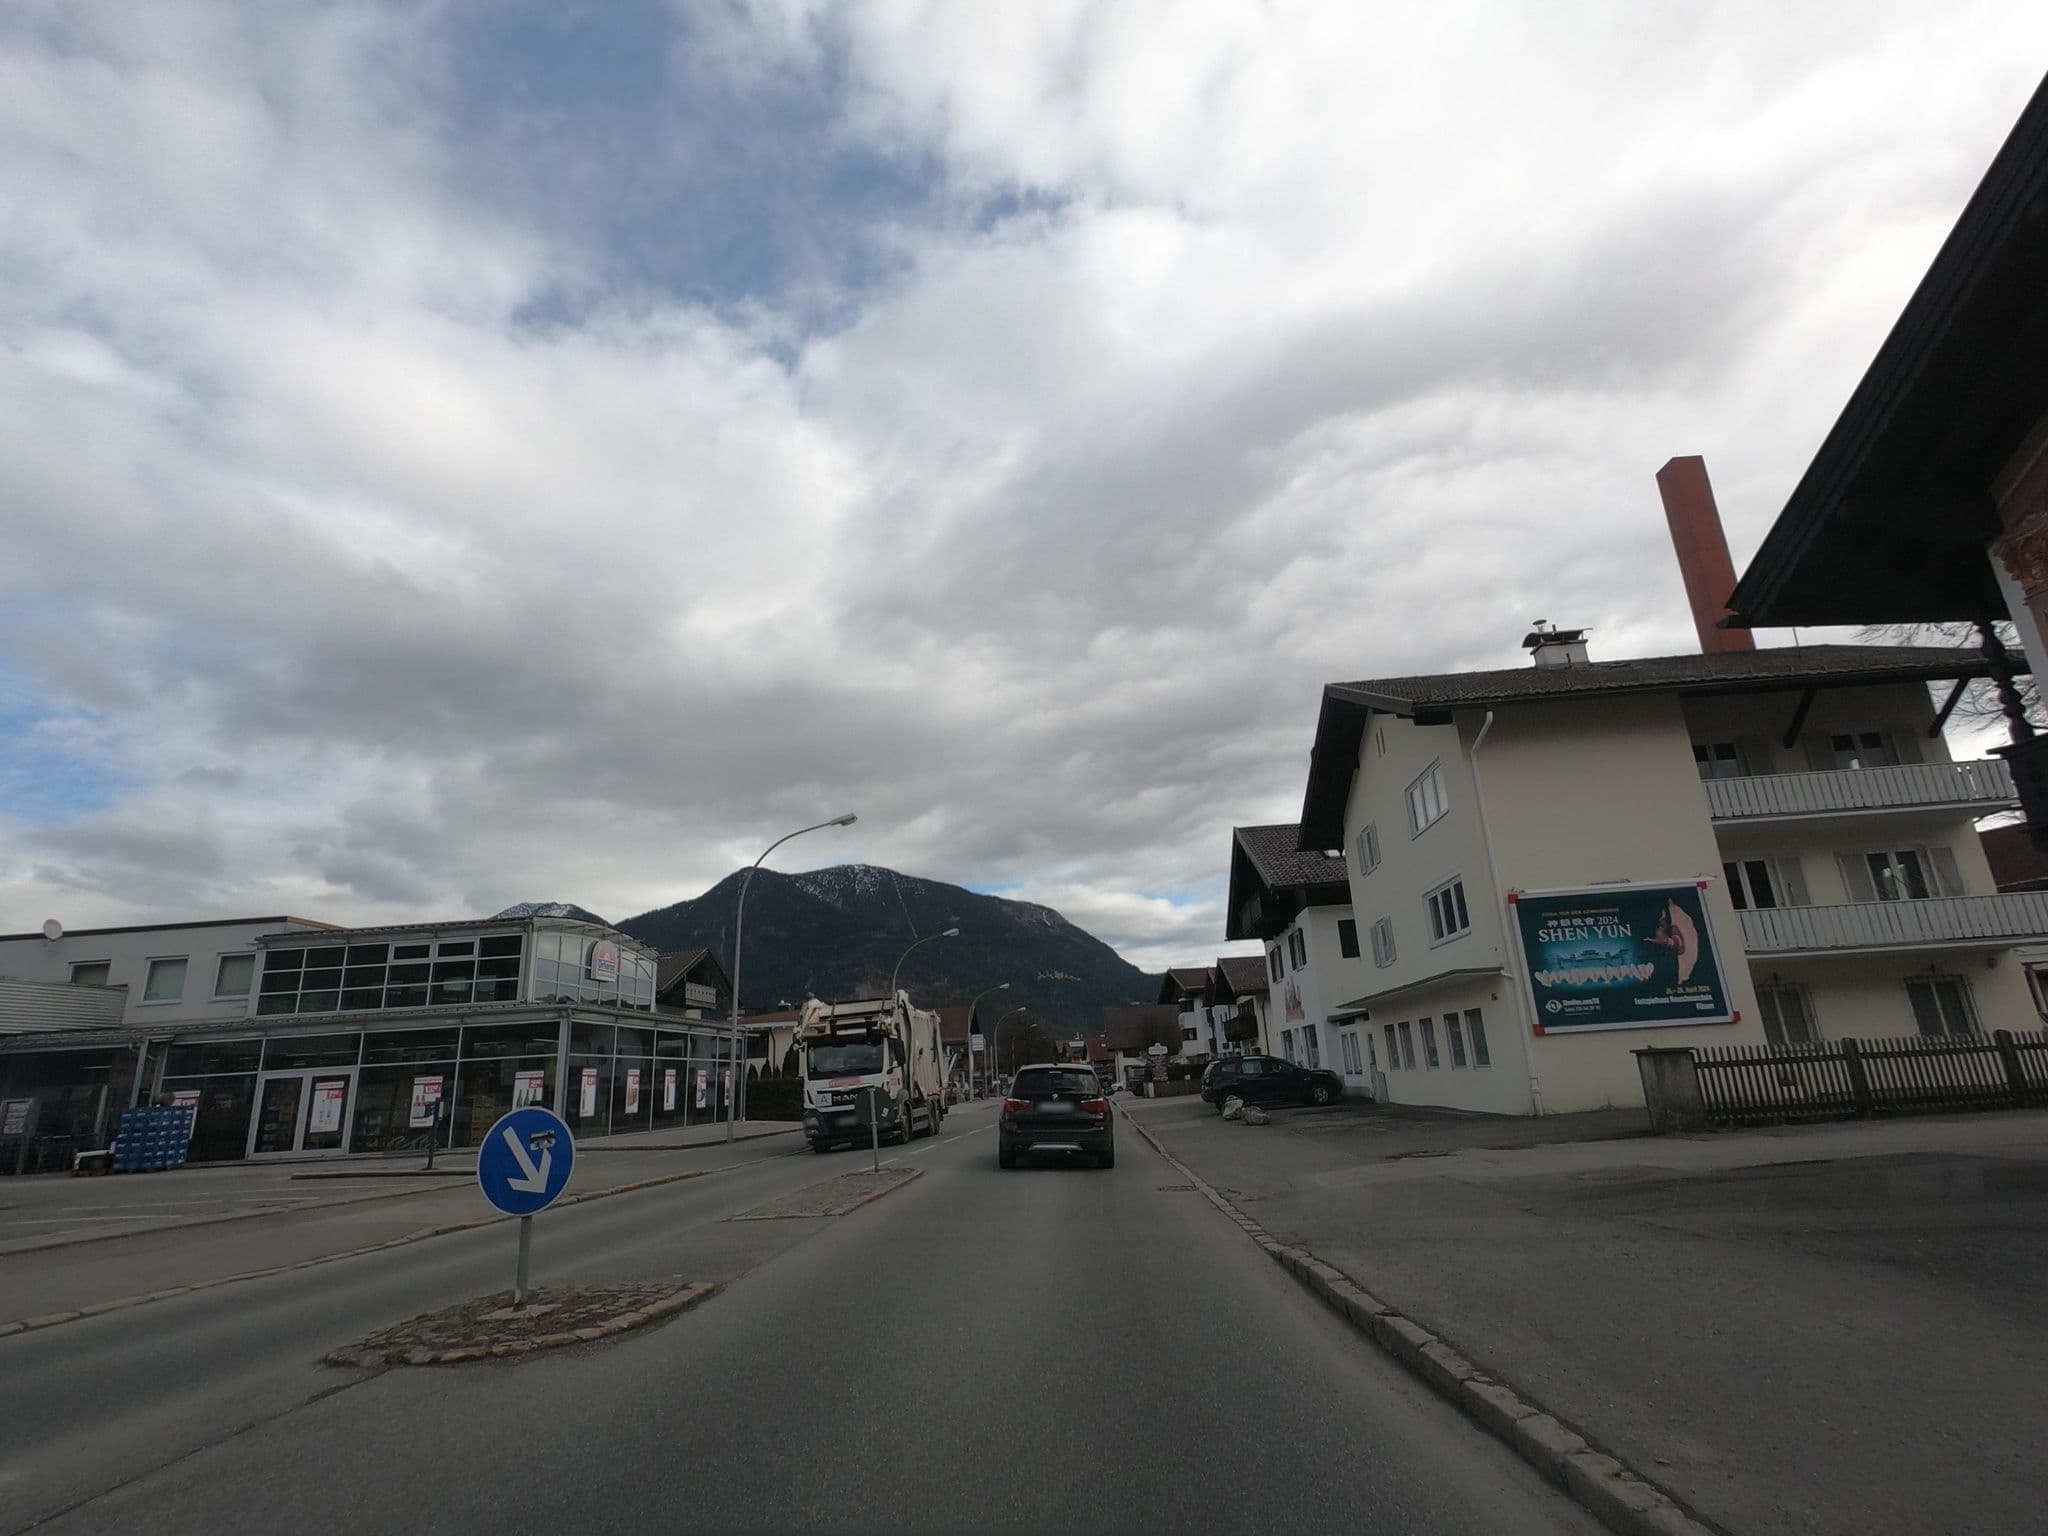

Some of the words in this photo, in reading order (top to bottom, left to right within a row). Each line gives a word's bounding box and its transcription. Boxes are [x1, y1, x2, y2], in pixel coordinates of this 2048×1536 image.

[1538, 926, 1588, 942] SHEN
[1592, 924, 1632, 939] YUN
[832, 1094, 858, 1102] MAN
